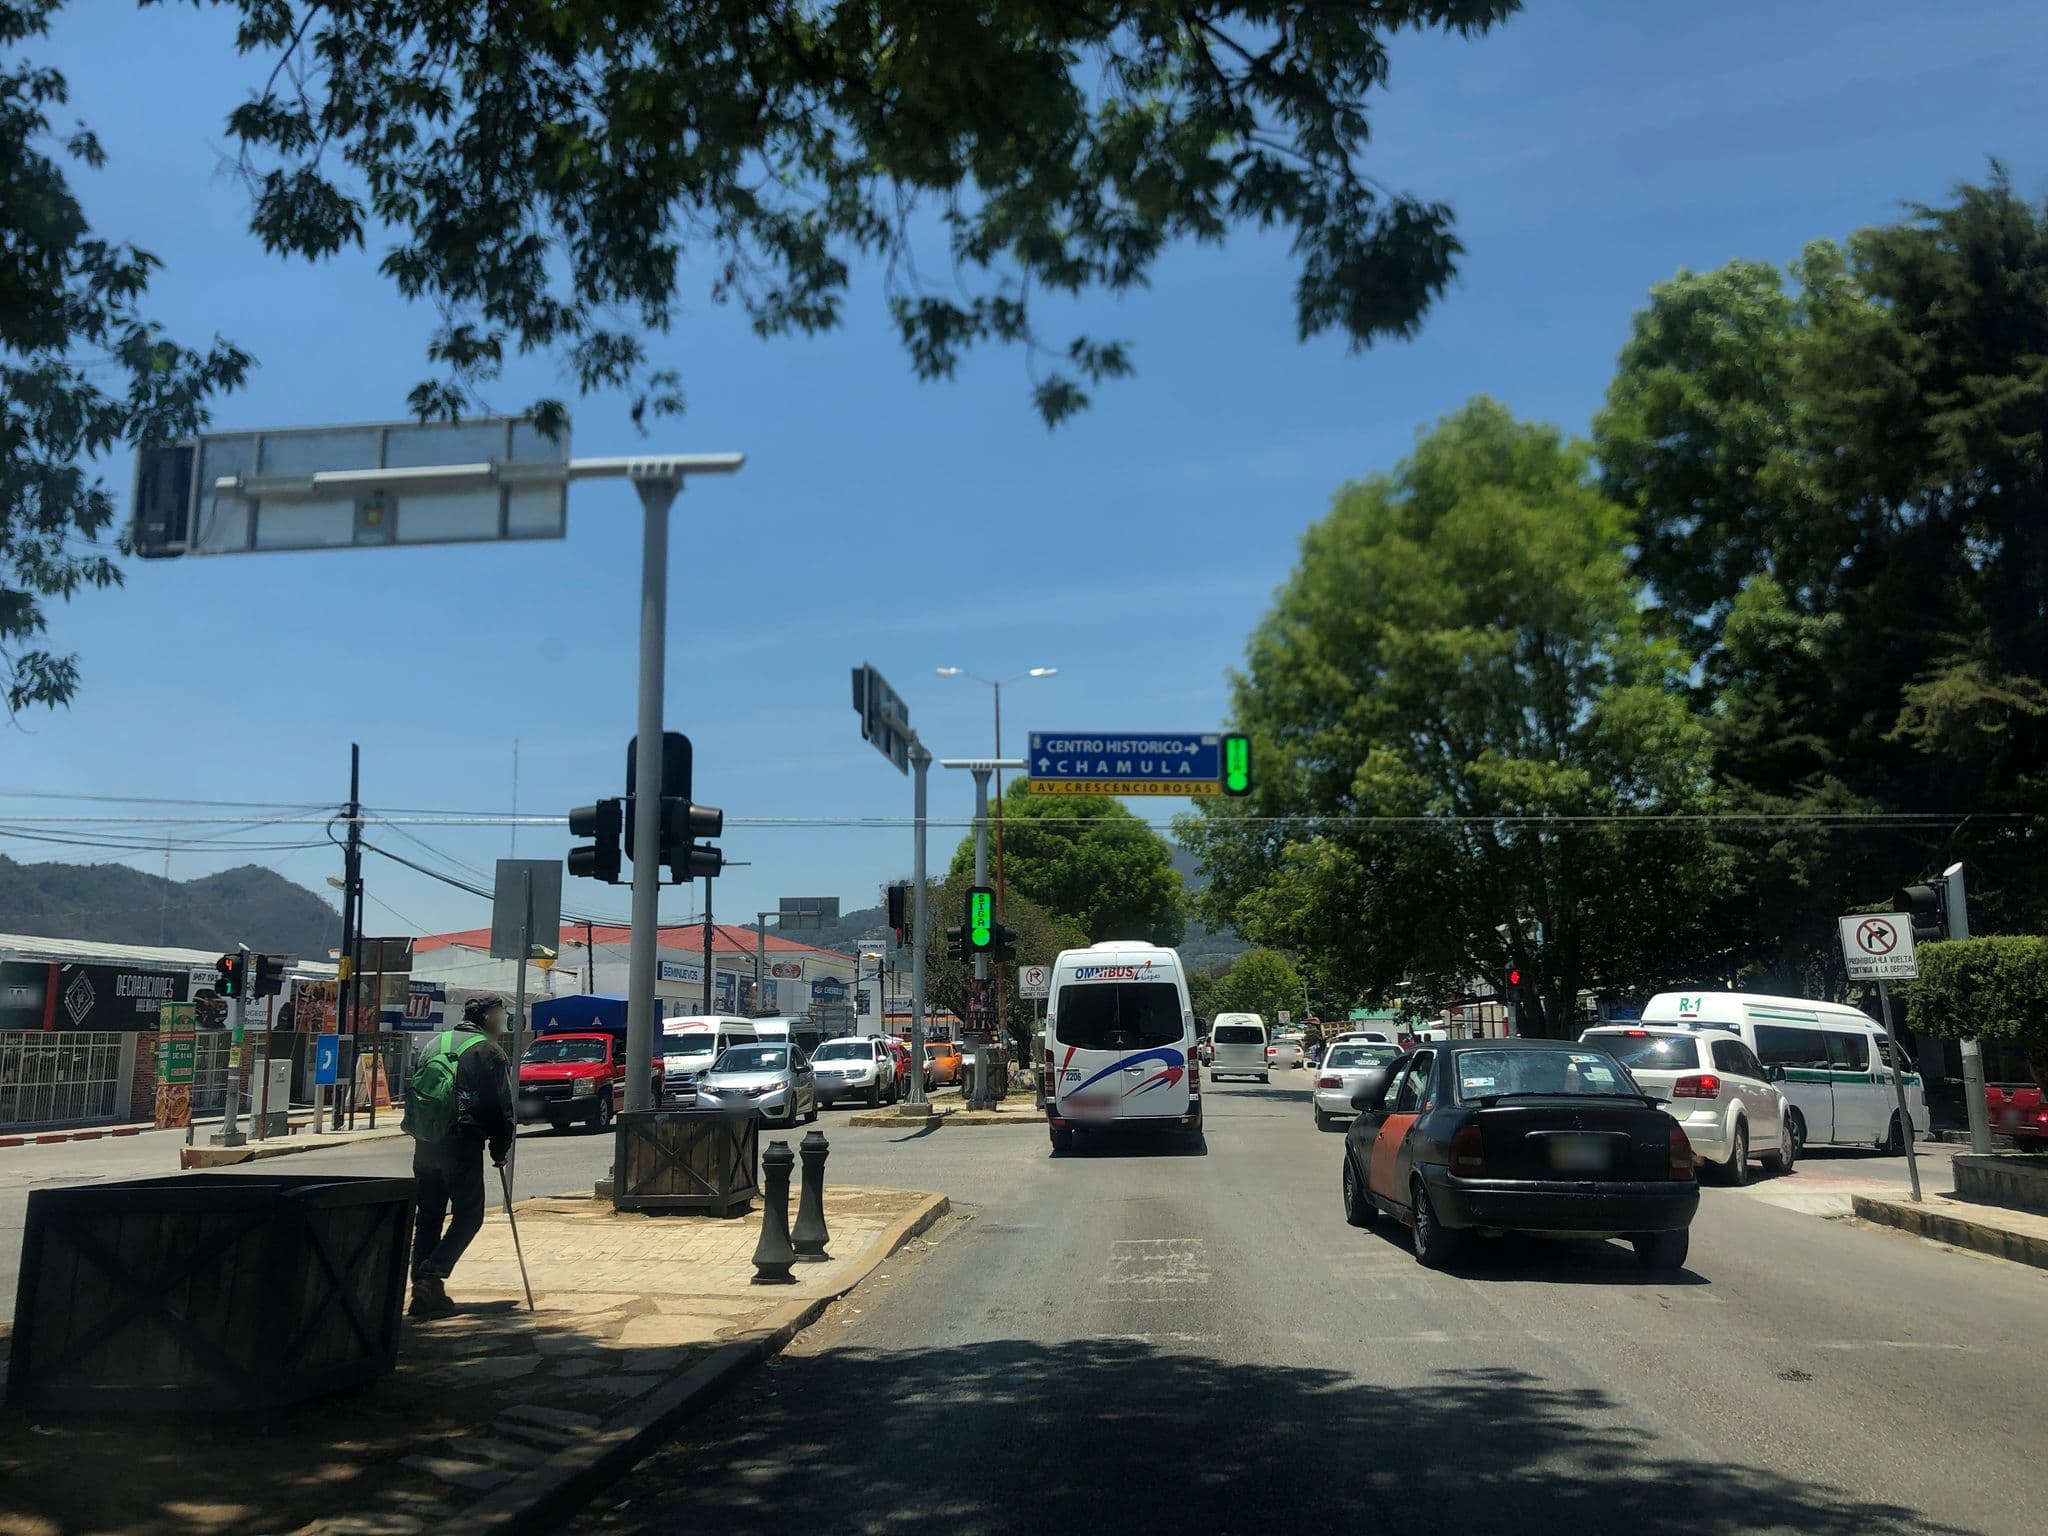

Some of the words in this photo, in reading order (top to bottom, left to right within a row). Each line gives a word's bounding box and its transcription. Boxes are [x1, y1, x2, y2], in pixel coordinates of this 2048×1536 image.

[1047, 739, 1103, 753] CENTRO
[1106, 740, 1183, 754] HISTORICO
[1056, 760, 1192, 774] CHAMULA
[1065, 783, 1158, 793] CRESCENCIO
[1163, 783, 1212, 793] ROSAS
[977, 894, 985, 926] SIGA
[1890, 955, 1913, 963] VUELTA
[664, 966, 698, 980] SEMINUEVOS
[116, 974, 174, 998] DECORACIONES
[1679, 997, 1702, 1012] R-1
[1066, 1072, 1081, 1081] 2206
